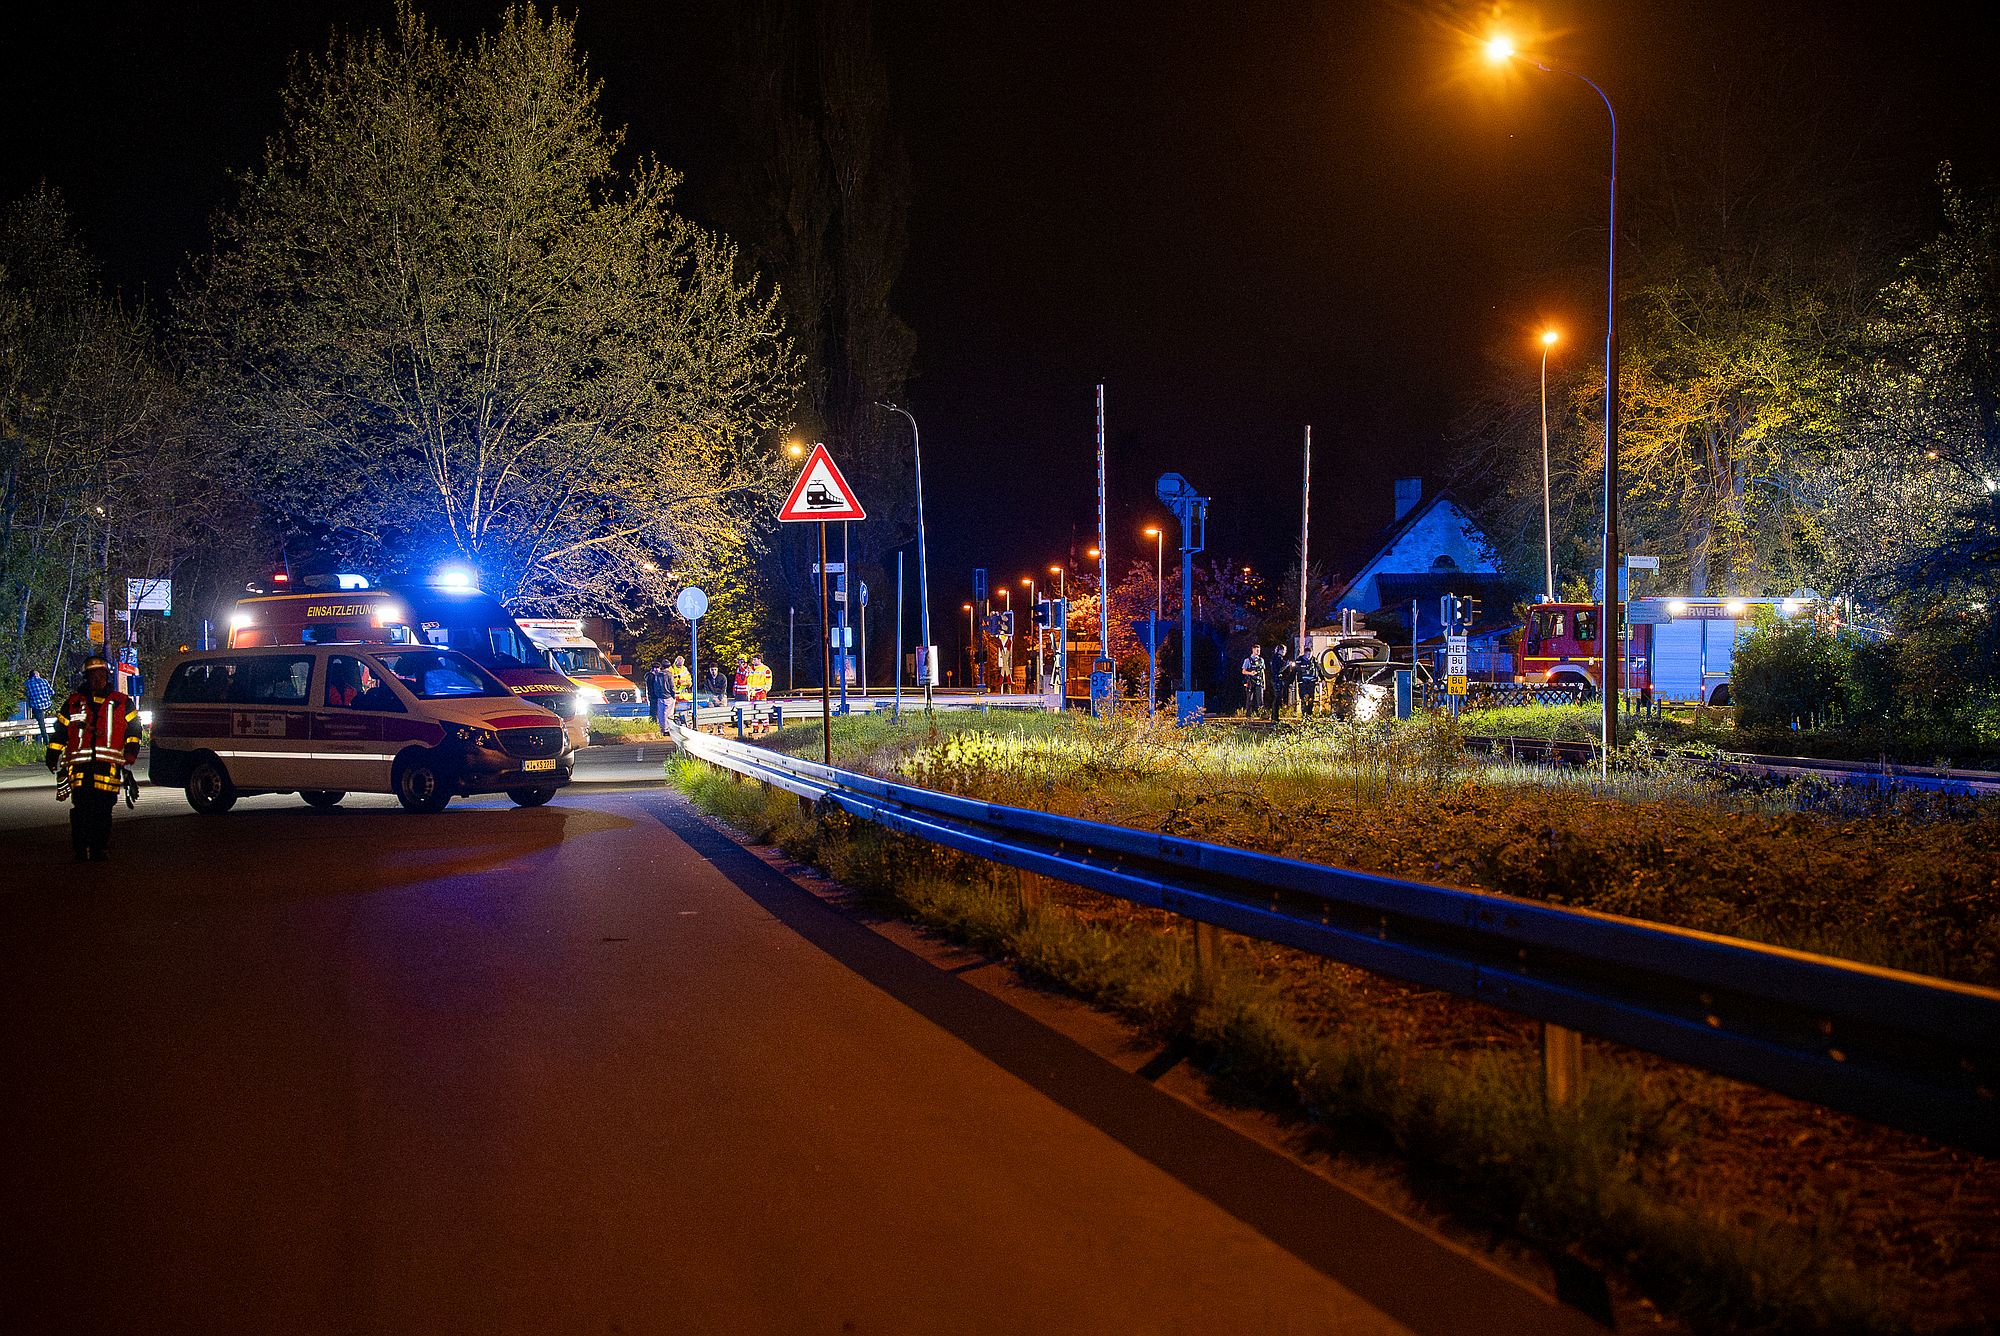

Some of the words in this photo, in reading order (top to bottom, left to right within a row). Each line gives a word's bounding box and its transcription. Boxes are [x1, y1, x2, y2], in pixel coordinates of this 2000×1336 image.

[307, 604, 377, 617] EINSATZLEITUNG
[1448, 645, 1466, 653] HET
[1452, 656, 1463, 665] Bü
[511, 684, 576, 694] EUERWEH
